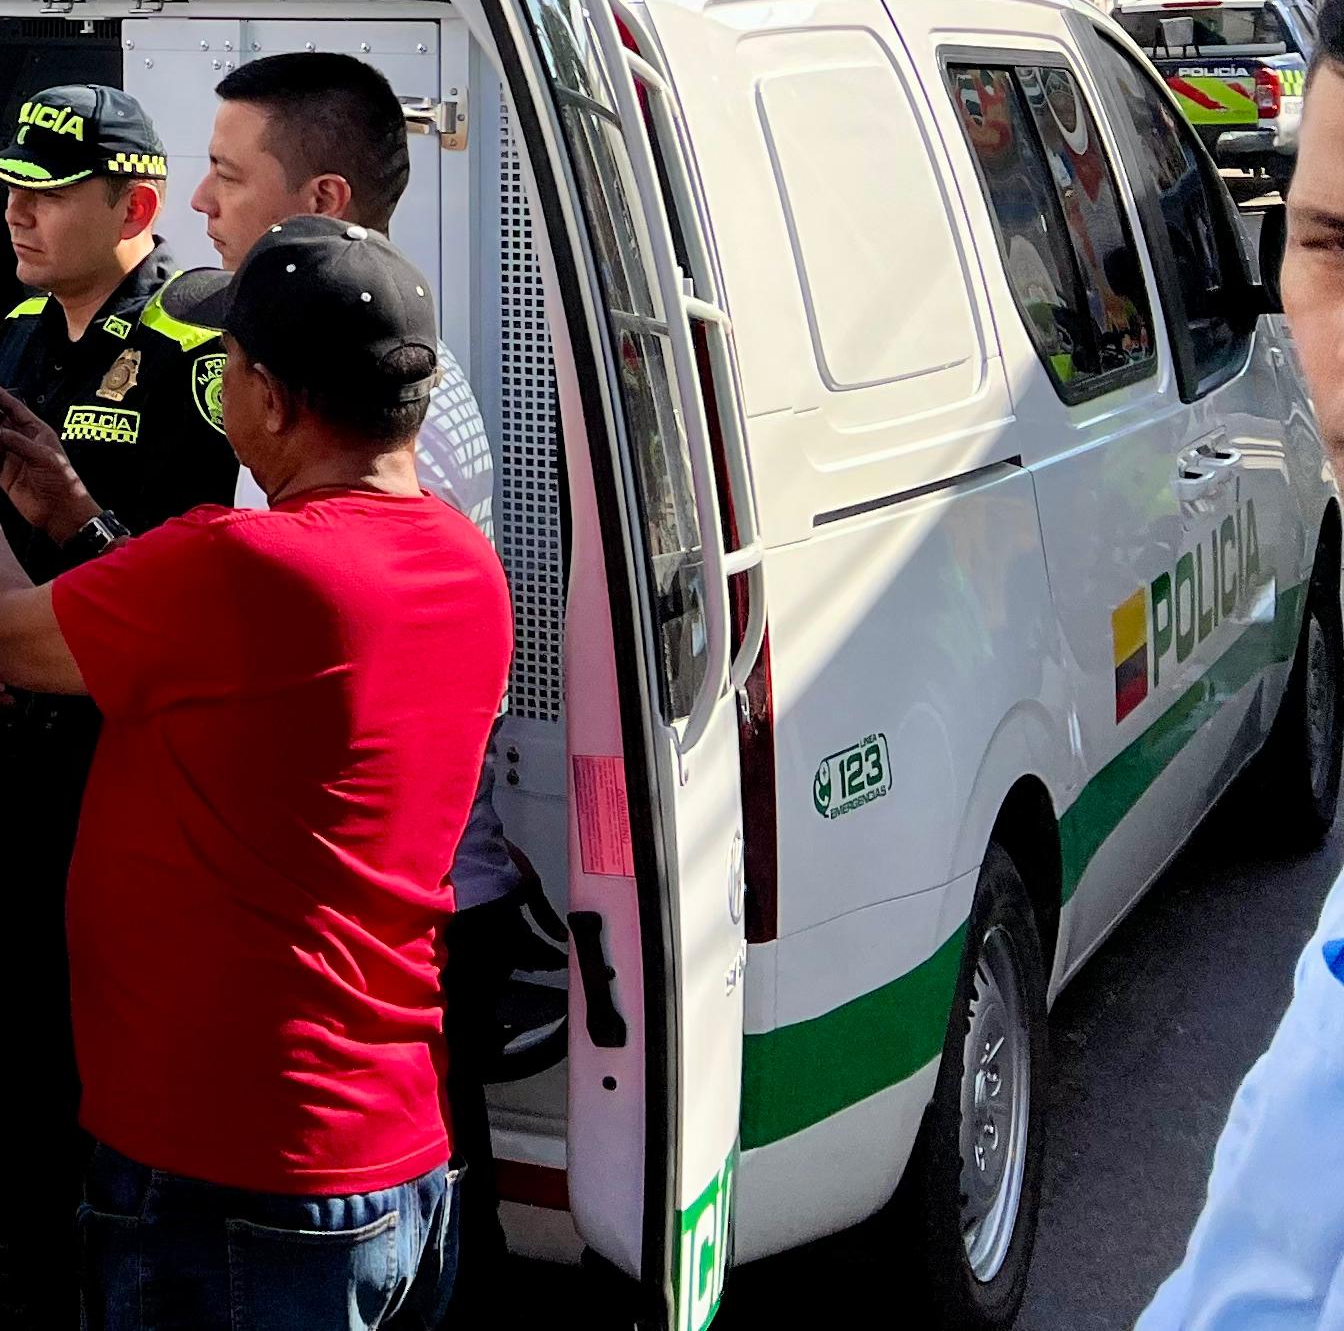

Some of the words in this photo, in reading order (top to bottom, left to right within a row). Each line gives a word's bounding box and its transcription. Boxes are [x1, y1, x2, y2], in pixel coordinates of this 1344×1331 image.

[1178, 64, 1251, 77] POLICÍA
[1150, 475, 1262, 688] POLICÍA
[838, 743, 883, 799] 123
[830, 785, 887, 820] EMERGENCIAS
